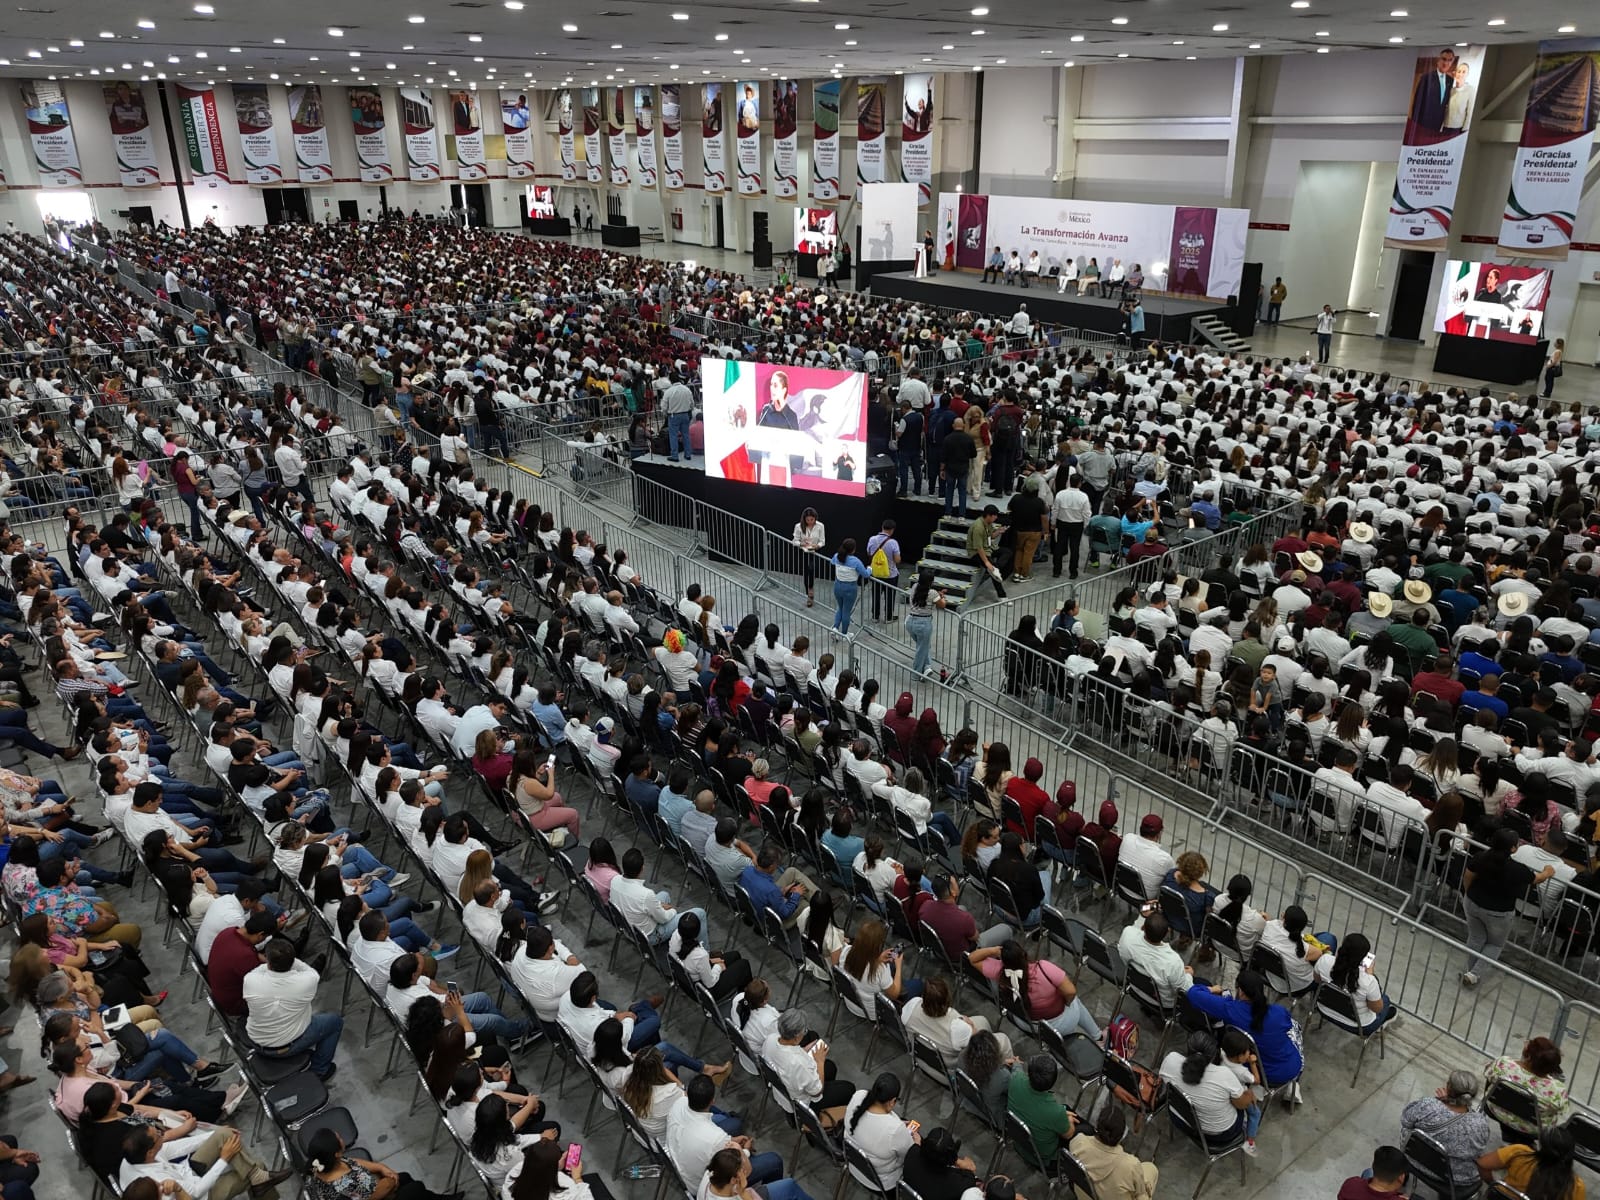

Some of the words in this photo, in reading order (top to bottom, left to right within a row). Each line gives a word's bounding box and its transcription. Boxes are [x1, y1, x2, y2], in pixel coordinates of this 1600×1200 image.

[182, 102, 198, 157] SOBERANÍA
[194, 102, 209, 148] LIBERTAD
[206, 102, 225, 169] INDEPENDENCIA
[1414, 148, 1448, 157] ¡Gracias
[1532, 150, 1571, 159] ¡Gracias
[1407, 157, 1454, 166] Presidenta!
[1523, 159, 1578, 168] Presidenta!
[1069, 215, 1091, 223] México
[1021, 225, 1030, 234] La
[1032, 226, 1095, 240] Transformación
[1098, 232, 1129, 243] Avanza
[1180, 247, 1200, 255] 2025
